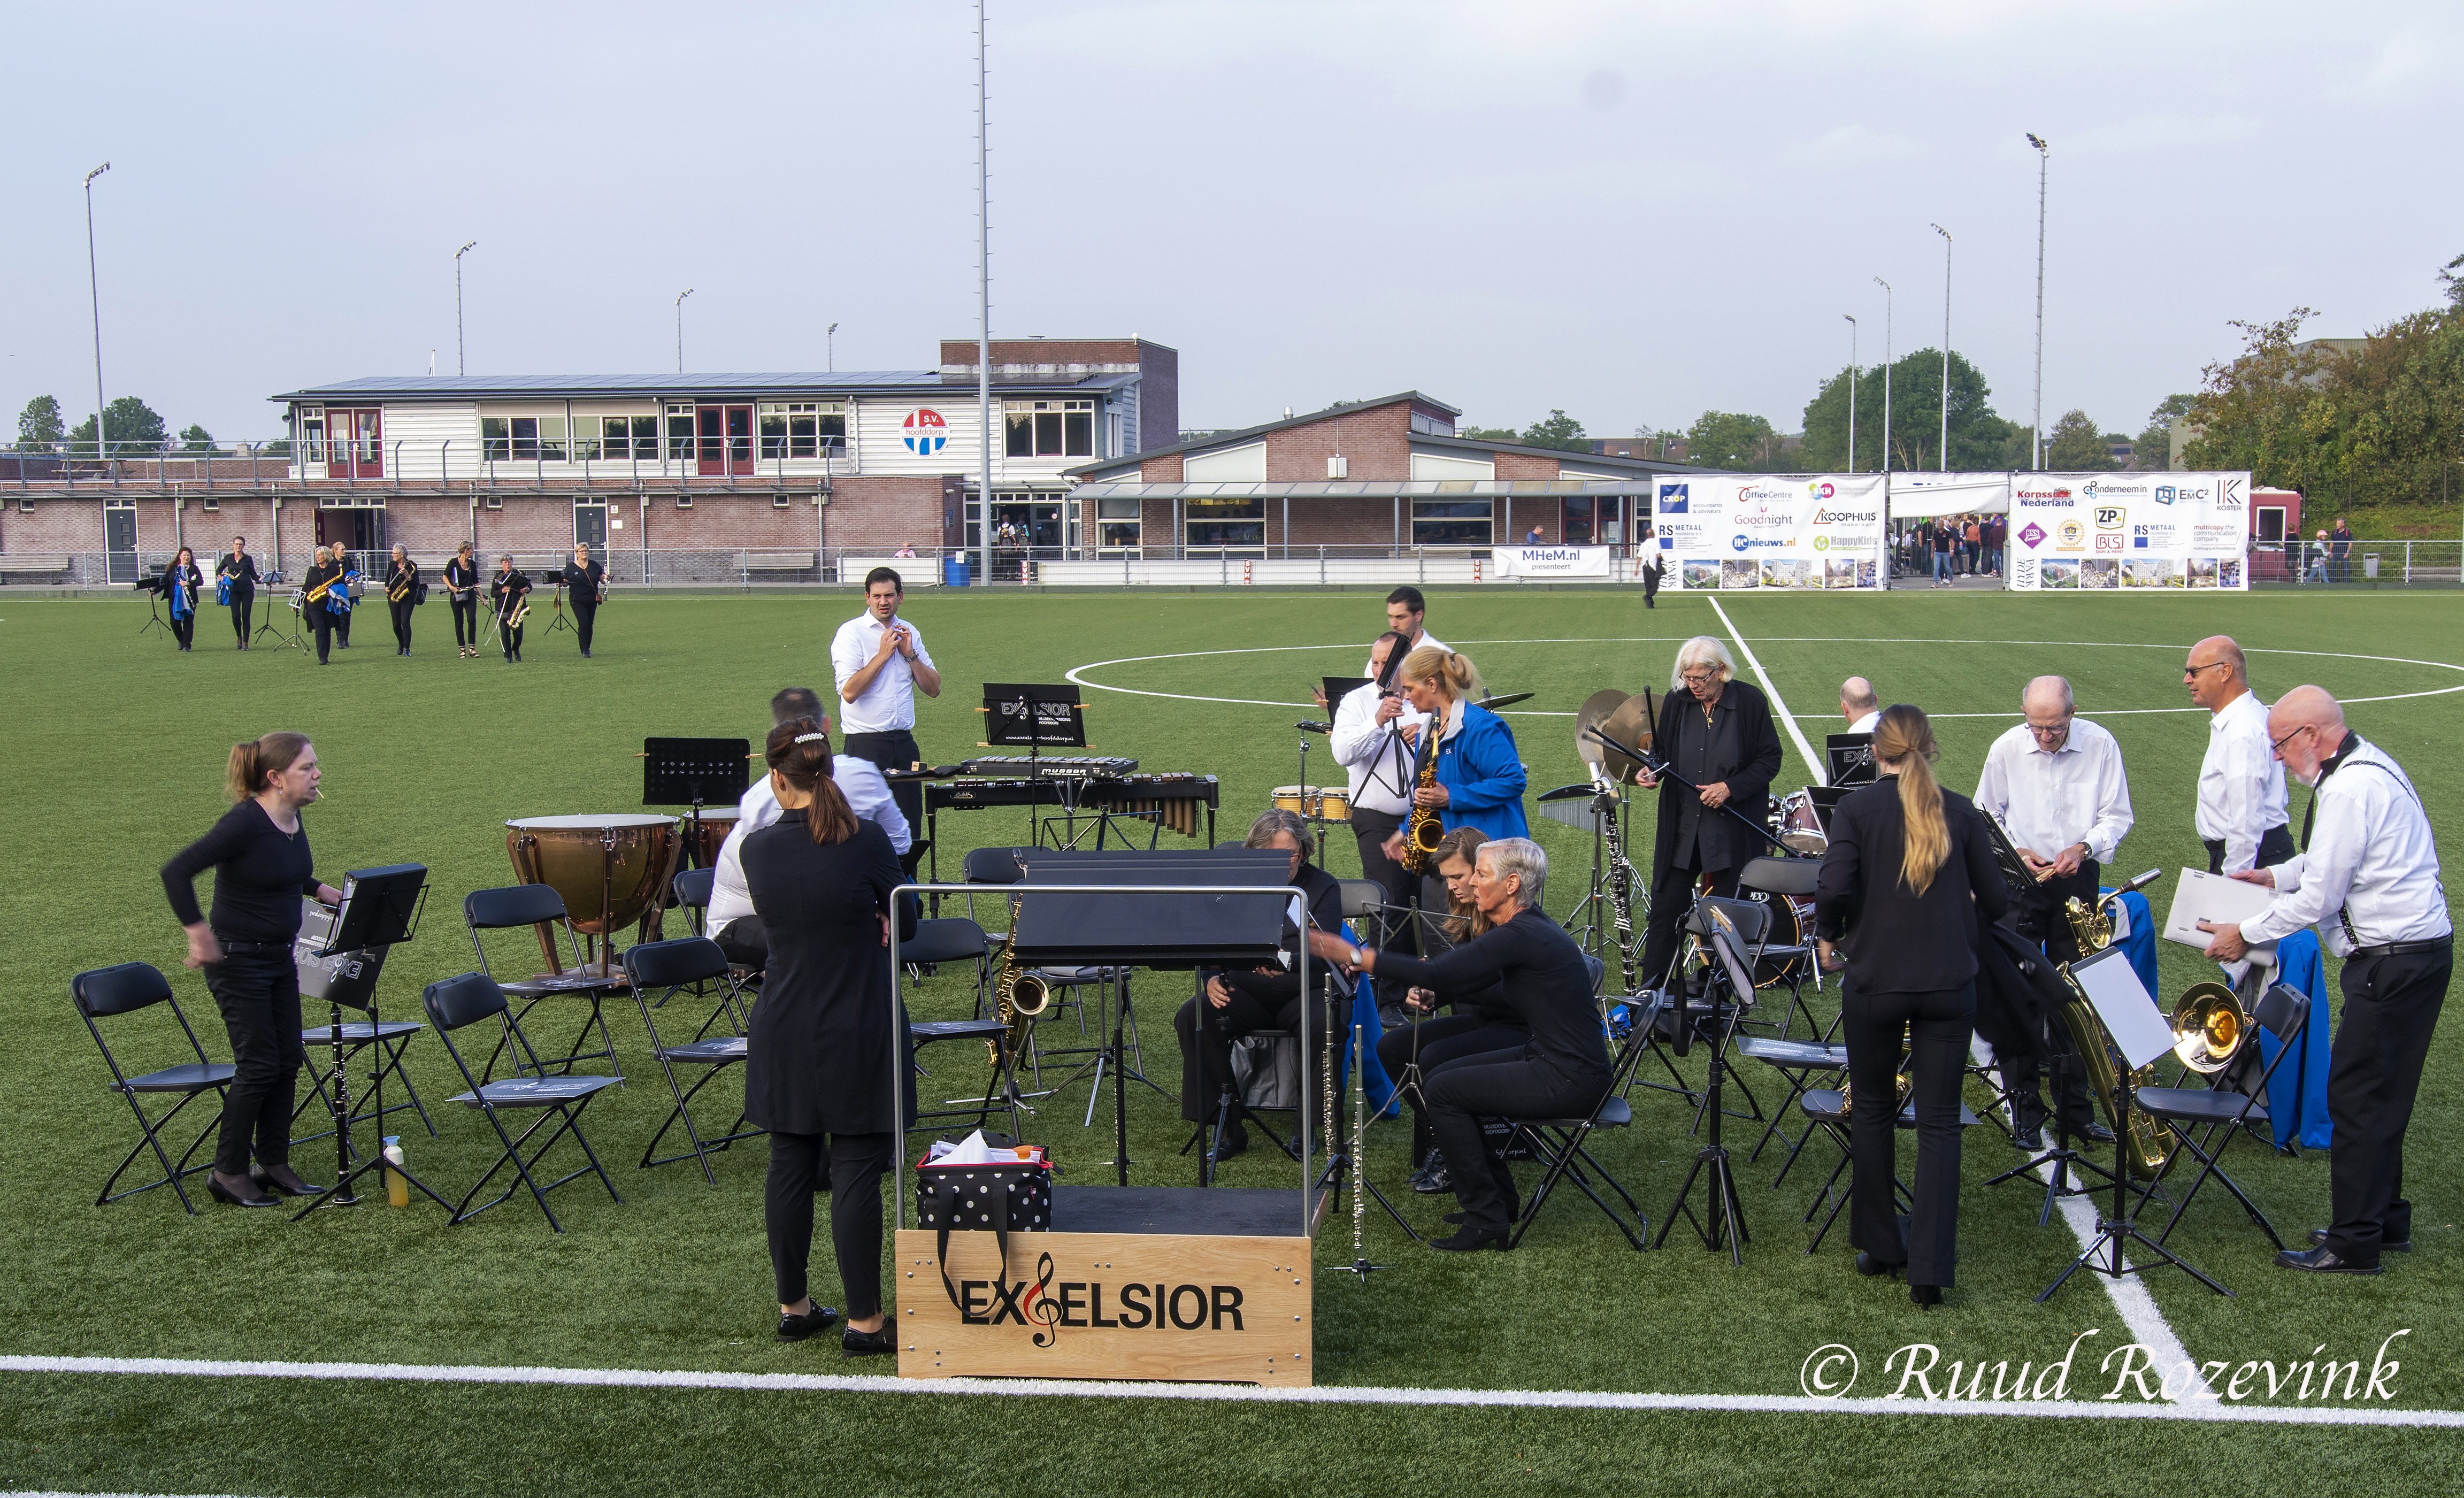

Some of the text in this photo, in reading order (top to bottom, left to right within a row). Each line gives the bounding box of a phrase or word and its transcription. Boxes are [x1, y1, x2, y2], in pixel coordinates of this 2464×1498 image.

[906, 428, 943, 436] hoofddorp
[1814, 487, 1832, 495] SKH
[1734, 514, 1793, 527] Goodnight
[1821, 512, 1876, 521] KOOPHUIS
[2099, 510, 2117, 523] ZP
[1659, 525, 1673, 536] RS
[2135, 525, 2148, 535] RS
[1831, 536, 1877, 546] HappyKids
[1523, 550, 1580, 560] MHeM.nl
[1668, 560, 1676, 588] PARK
[2017, 558, 2025, 588] HYDE
[2026, 558, 2034, 588] PARK
